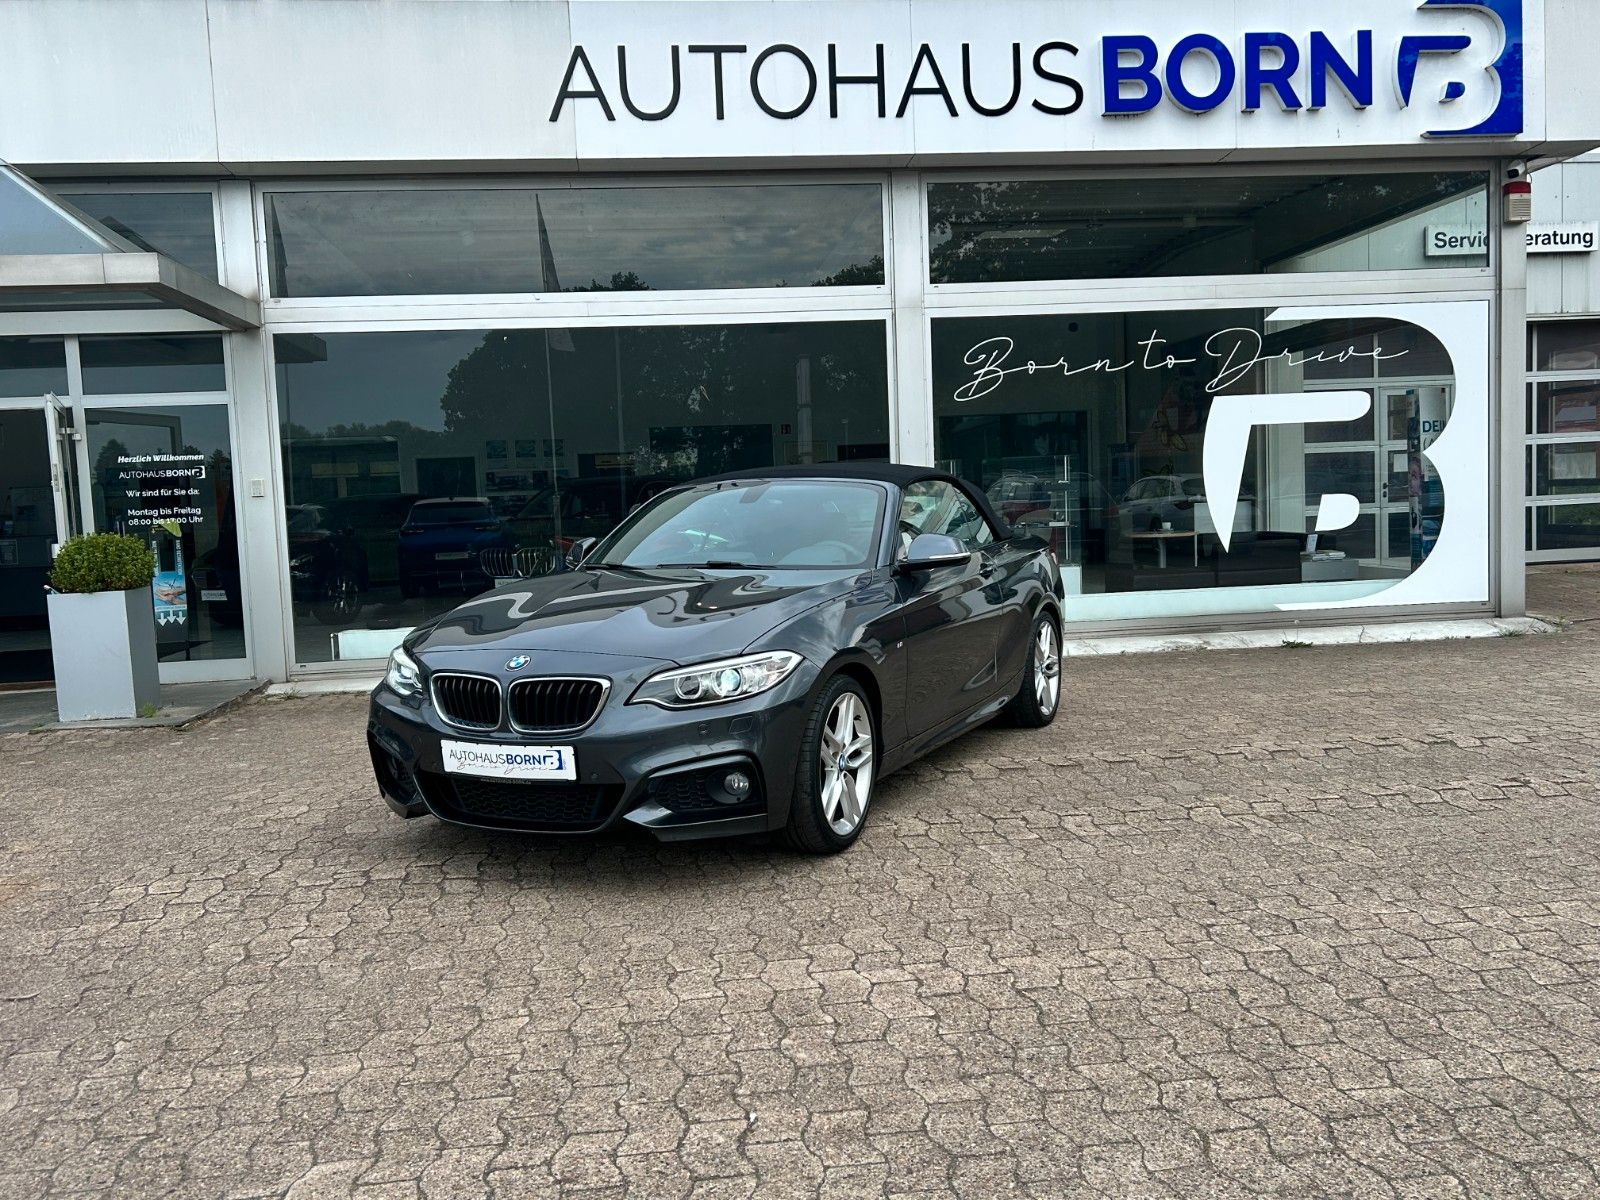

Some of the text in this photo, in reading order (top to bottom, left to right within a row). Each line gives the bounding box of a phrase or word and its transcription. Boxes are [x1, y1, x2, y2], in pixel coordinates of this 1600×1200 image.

[1526, 231, 1593, 248] eratung
[954, 327, 1409, 401] Born to Drive
[1422, 420, 1446, 433] DEI
[117, 454, 204, 463] Herzlich Willkommen
[142, 489, 159, 497] sind
[160, 488, 172, 496] für
[173, 488, 186, 496] Sie
[127, 508, 158, 517] Montag
[173, 507, 202, 515] Freitag
[128, 518, 151, 526] 08:00
[152, 517, 165, 525] bis
